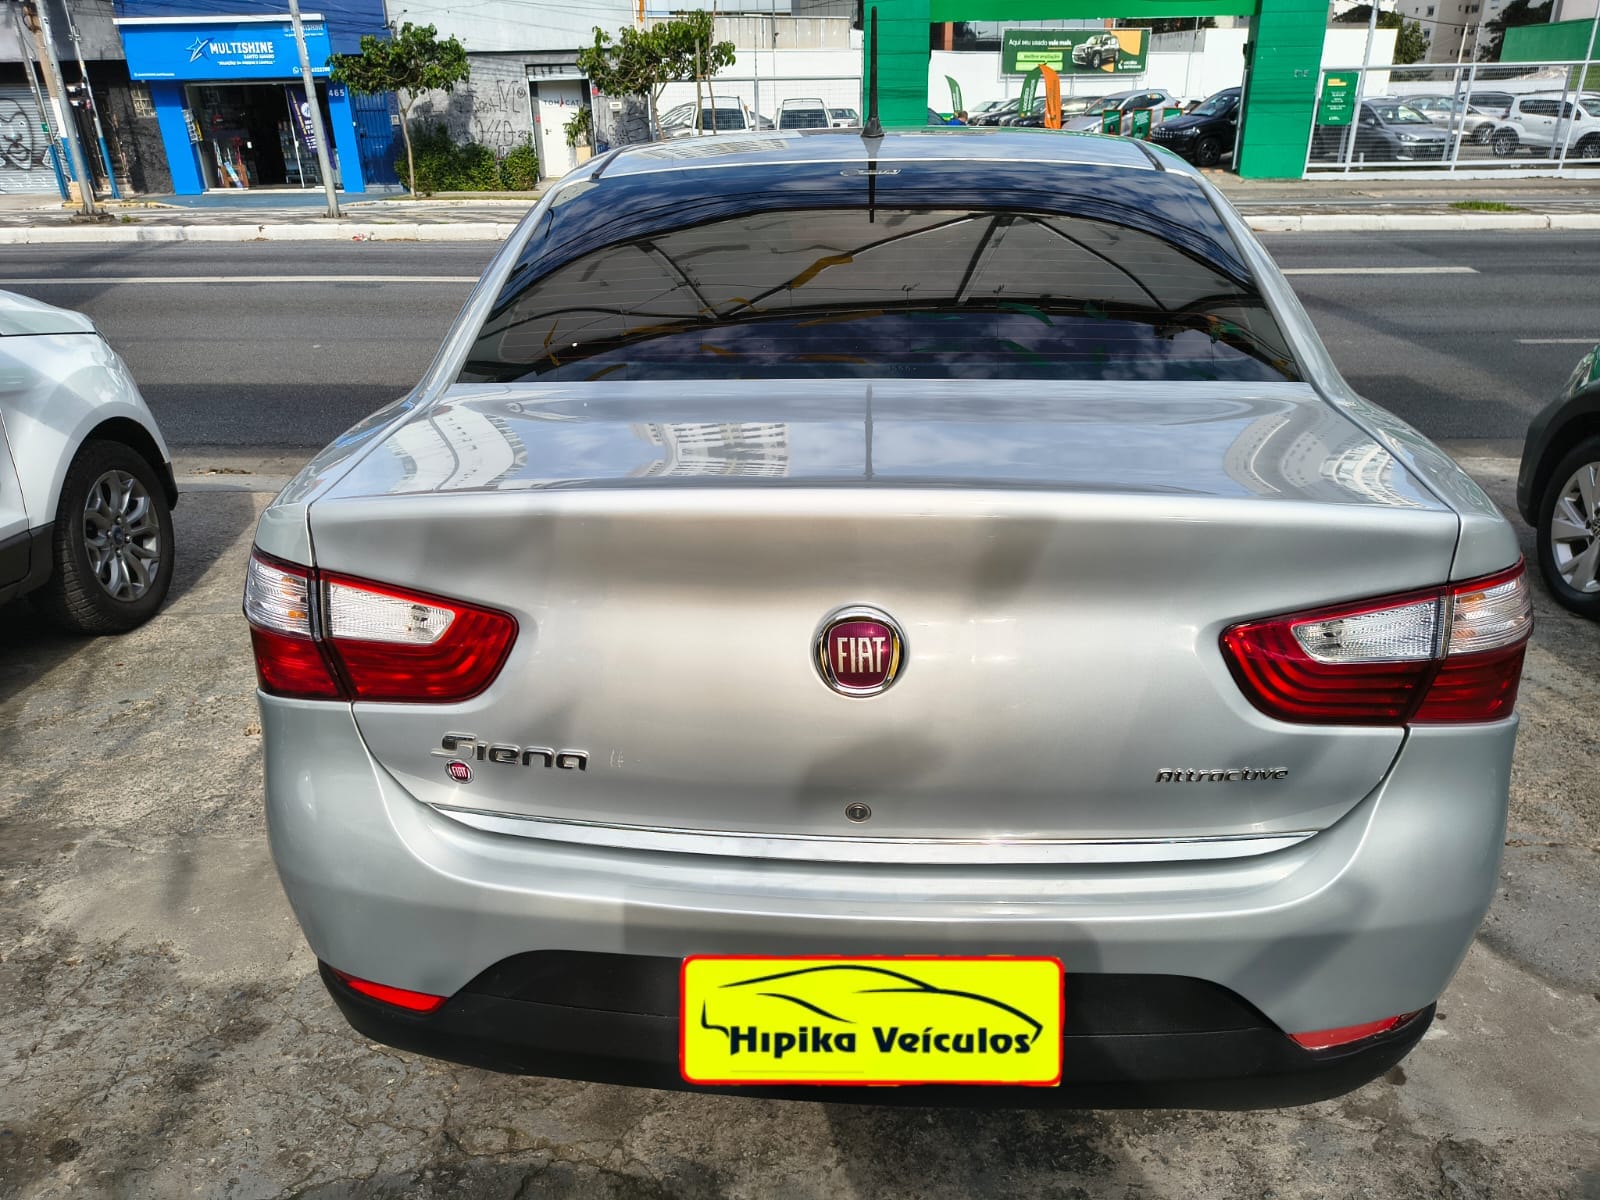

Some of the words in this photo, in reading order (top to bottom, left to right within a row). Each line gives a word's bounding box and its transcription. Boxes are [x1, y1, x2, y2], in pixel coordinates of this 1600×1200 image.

[209, 41, 274, 55] MULTISHINE
[1009, 39, 1021, 47] Aqui
[328, 89, 345, 97] 465
[837, 636, 886, 673] FIAT
[430, 731, 590, 771] Siena
[451, 766, 468, 778] FIAT
[1155, 766, 1289, 783] Attractive
